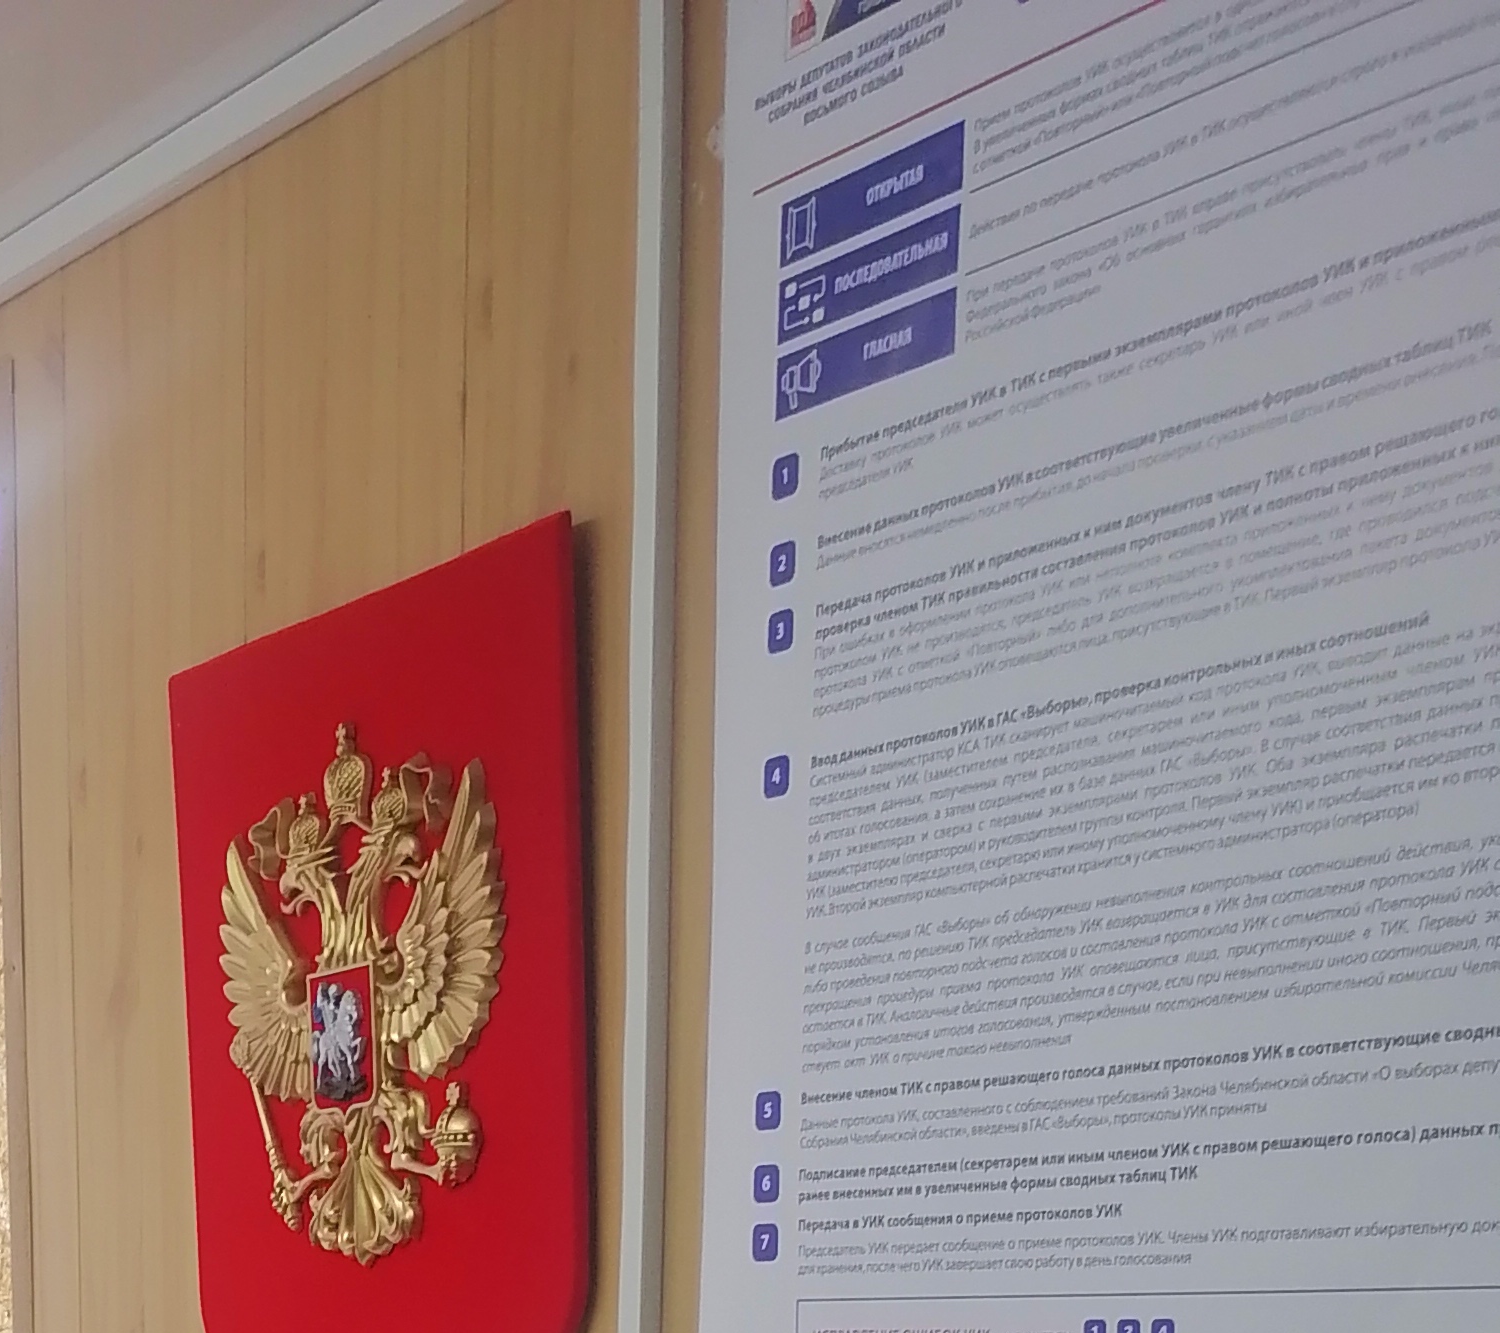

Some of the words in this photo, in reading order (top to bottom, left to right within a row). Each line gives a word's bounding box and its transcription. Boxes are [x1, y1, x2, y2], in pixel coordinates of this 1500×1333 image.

[899, 23, 946, 59] ОБЛАСТИ
[866, 165, 924, 206] ОТКРЫТАЯ
[833, 232, 948, 295] ПОСЛЕДОВАТЕЛЬНАЯ
[862, 327, 912, 361] ГЛАСНАЯ
[801, 1091, 852, 1104] Внесение
[855, 1087, 897, 1099] членом
[900, 1081, 922, 1095] ТИК
[924, 1084, 930, 1092] с
[932, 1079, 980, 1094] правом
[983, 1071, 1059, 1090] решающего
[1062, 1067, 1104, 1079] голоса
[1108, 1061, 1159, 1077] данных
[1163, 1053, 1248, 1072] протоколов
[1251, 1045, 1283, 1061] УИК
[1286, 1048, 1294, 1058] в
[1299, 1034, 1439, 1056] соответствующие
[798, 1168, 866, 1182] Подписание
[869, 1162, 956, 1179] председателем
[959, 1156, 1037, 1172] (секретарем
[1041, 1155, 1064, 1164] или
[1068, 1152, 1104, 1163] иным
[1108, 1148, 1157, 1160] членом
[1161, 1143, 1189, 1157] УИК
[1193, 1145, 1199, 1155] с
[1203, 1141, 1257, 1157] правом
[1261, 1135, 1352, 1153] решающего
[1356, 1127, 1415, 1144] голоса)
[1419, 1126, 1482, 1142] данных
[798, 1191, 830, 1205] ранее
[833, 1188, 893, 1200] внесенных
[896, 1187, 912, 1196] им
[915, 1186, 921, 1195] в
[924, 1181, 1007, 1198] увеличенные
[1010, 1178, 1056, 1193] формы
[1059, 1175, 1115, 1188] сводных
[1118, 1171, 1166, 1184] таблиц
[1169, 1167, 1198, 1181] ТИК
[798, 1220, 849, 1234] Передача
[852, 1220, 859, 1229] в
[862, 1216, 884, 1228] УИК
[887, 1215, 952, 1228] сообщения
[956, 1215, 962, 1224] о
[966, 1213, 1013, 1227] приеме
[1016, 1210, 1092, 1225] протоколов
[1096, 1205, 1122, 1218] УИК
